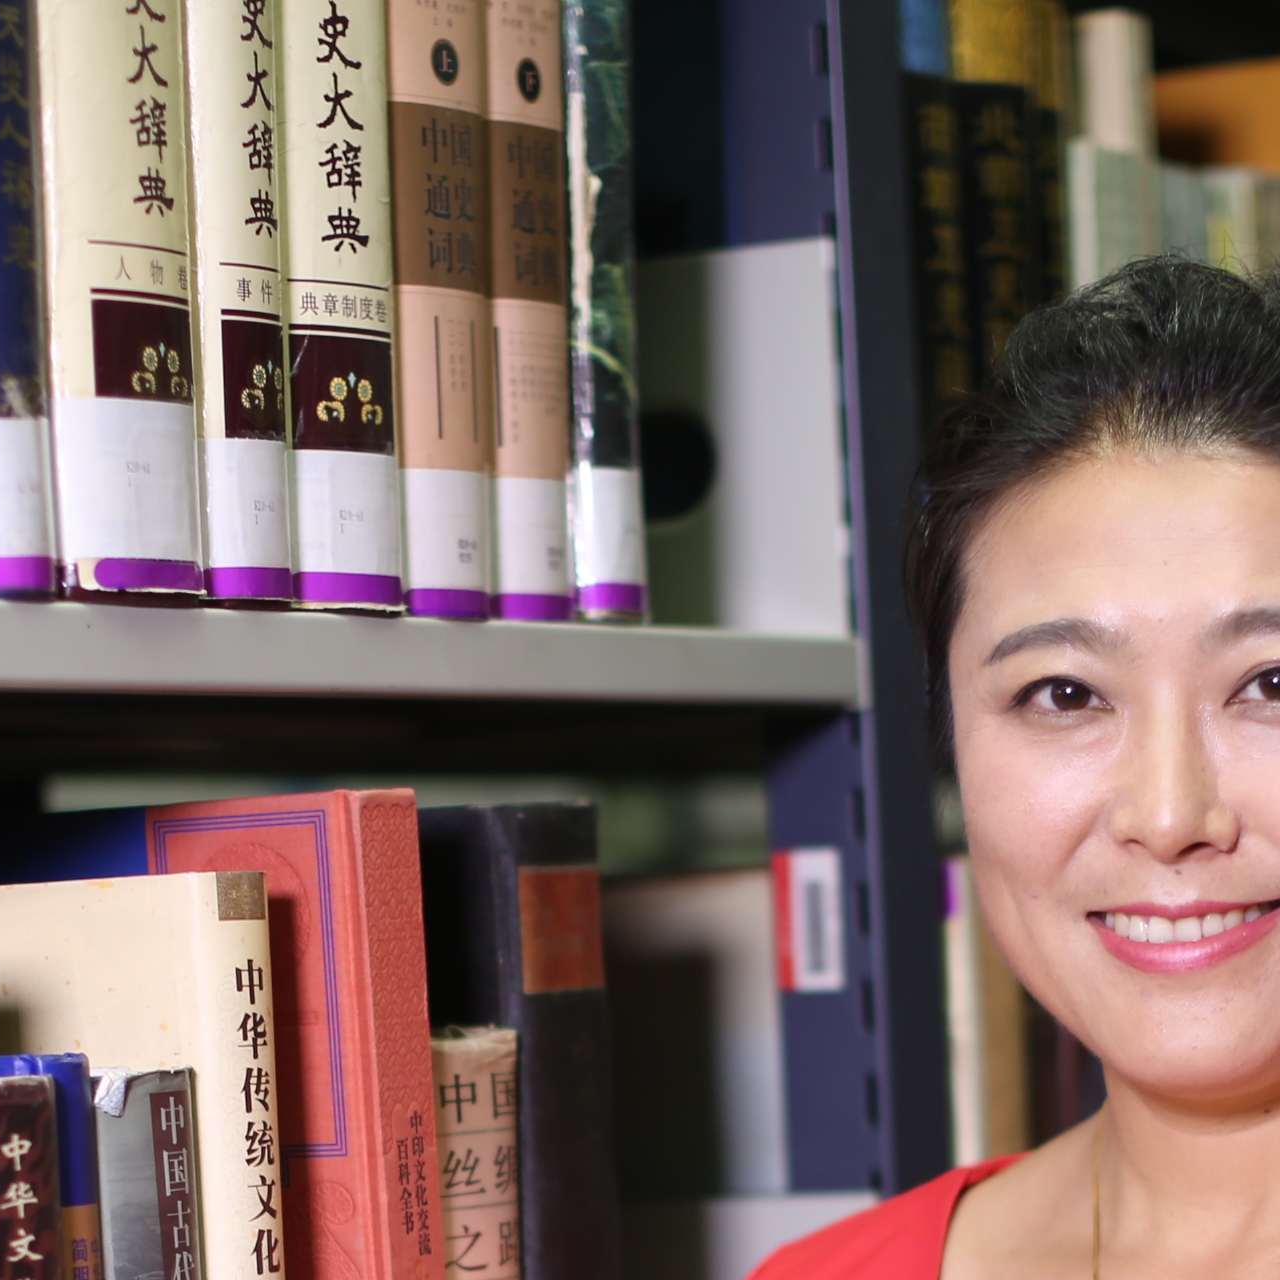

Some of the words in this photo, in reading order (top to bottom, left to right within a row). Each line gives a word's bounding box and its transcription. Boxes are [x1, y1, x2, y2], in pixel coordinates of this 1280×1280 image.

[241, 0, 278, 237] 史大辞典
[317, 1, 369, 253] 史大辞典
[236, 277, 273, 304] 事件
[299, 291, 388, 323] 典章制度卷
[439, 1072, 517, 1124] 中国
[396, 1138, 414, 1235] 百科全书
[410, 1111, 432, 1256] 中印文化交流
